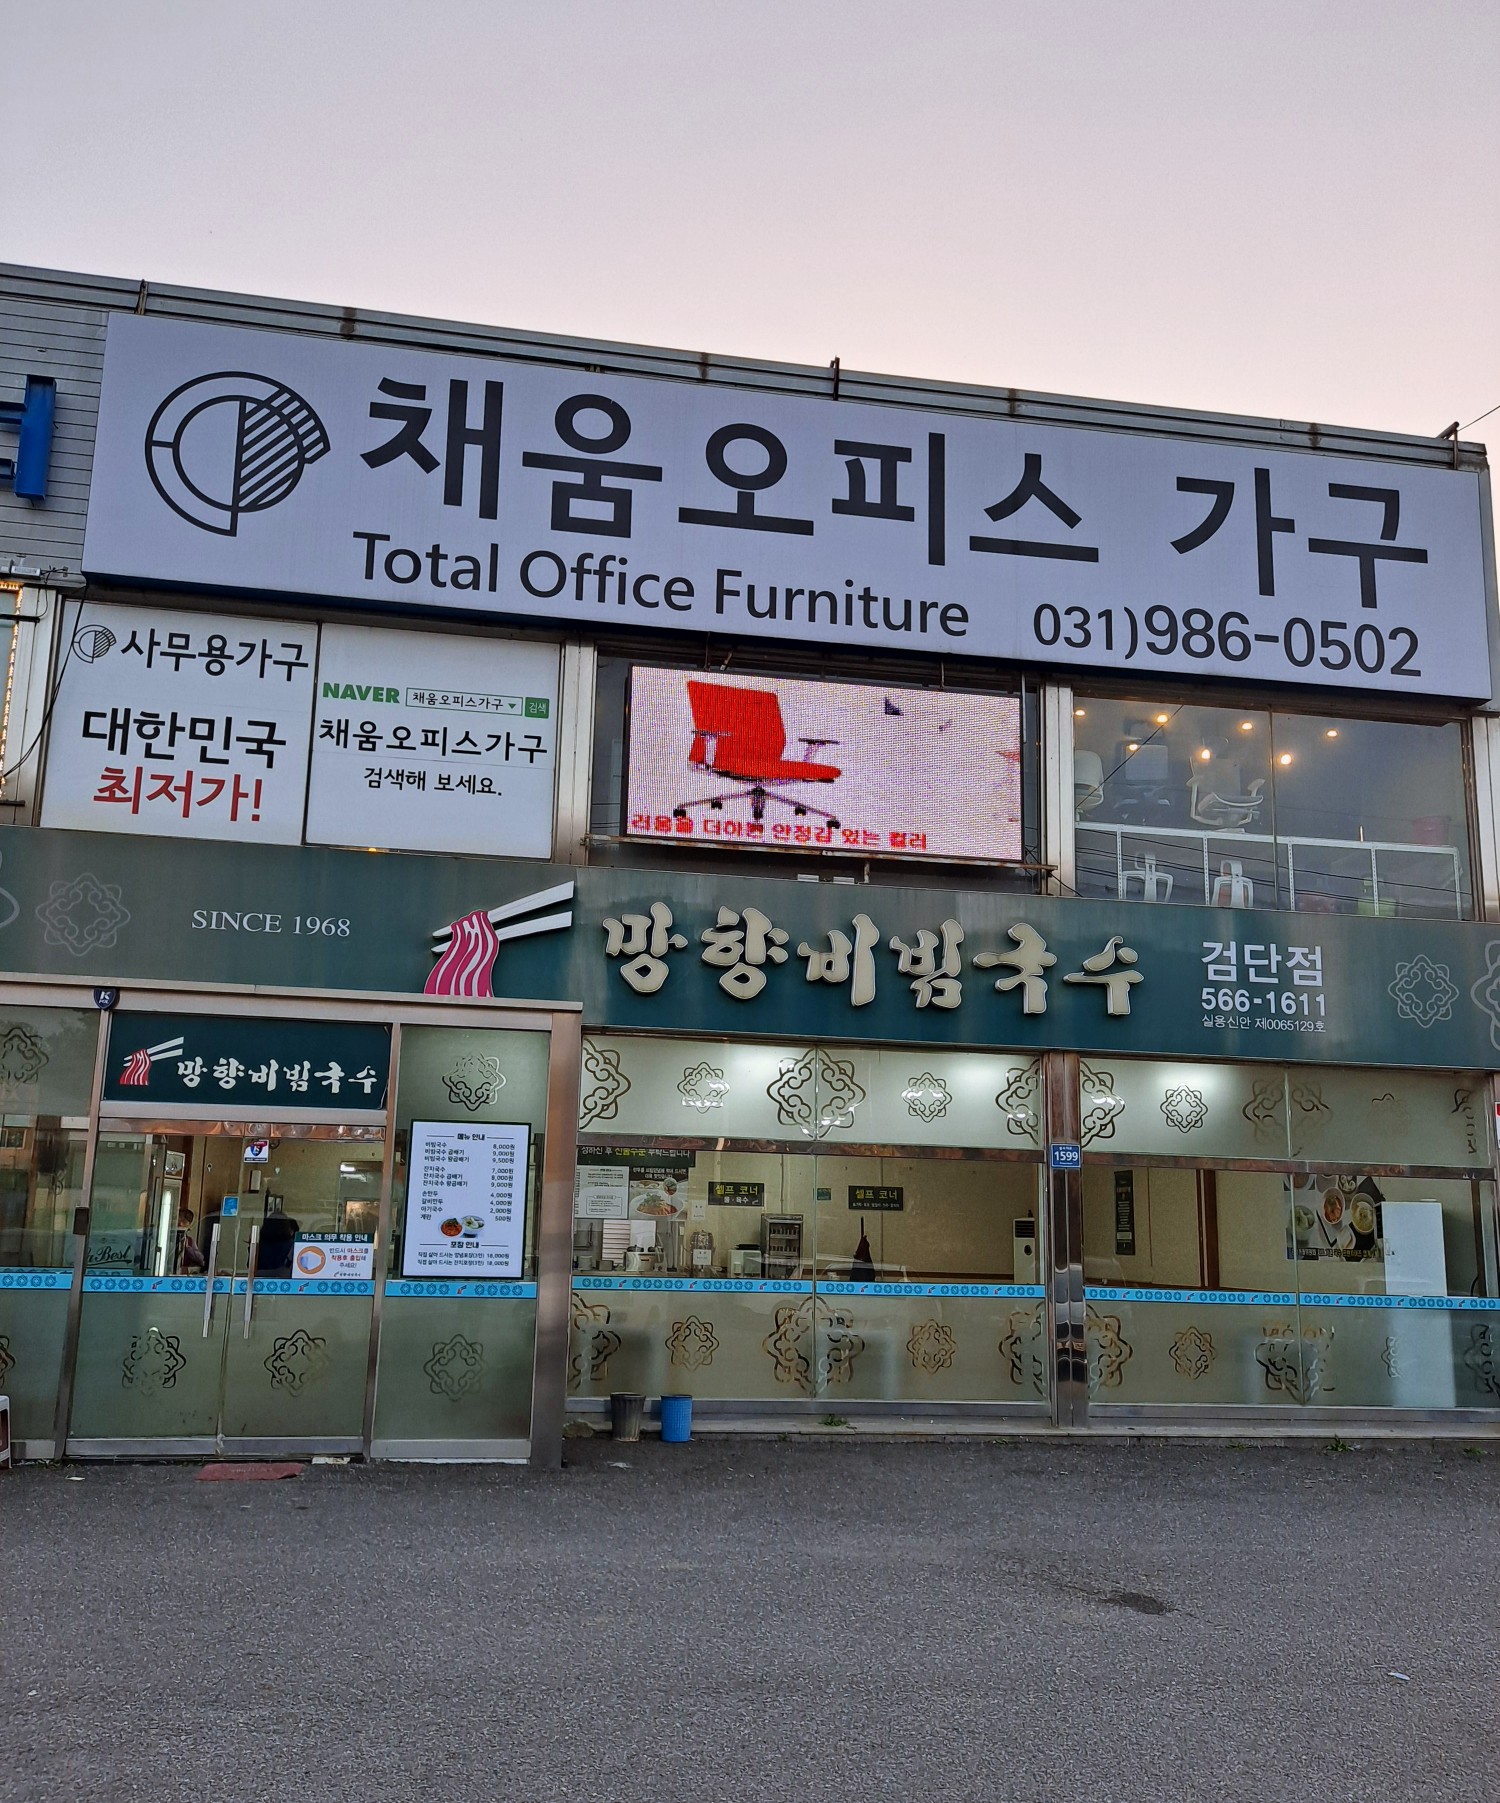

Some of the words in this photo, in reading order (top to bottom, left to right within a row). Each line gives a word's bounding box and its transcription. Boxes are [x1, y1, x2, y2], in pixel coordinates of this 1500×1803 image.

[360, 377, 1099, 566] 채움오피스
[1169, 467, 1428, 609] 가구
[352, 531, 498, 593] Total
[519, 550, 695, 611] Office
[716, 569, 969, 636] Furniture
[120, 627, 309, 682] 사무용가구
[1033, 603, 1421, 677] 031)986-0502
[322, 682, 400, 704] NAVER
[412, 691, 505, 712] 채움오피스가구
[528, 700, 548, 716] 검색
[82, 707, 286, 769] 대한민국
[319, 718, 548, 765] 채움오피스가구
[93, 766, 263, 822] 최저가!
[363, 766, 426, 792] 검색해
[434, 771, 503, 797] 보세요.
[192, 909, 282, 933] SINCE
[292, 915, 351, 938] 1968
[602, 901, 1145, 1016] 망향비빔국수
[1201, 941, 1324, 987] 검단점
[1201, 988, 1326, 1016] 566-1611
[1201, 1014, 1252, 1030] 실용신안
[1254, 1016, 1327, 1033] 제0065129호
[177, 1057, 378, 1093] 망향비빔국수
[1054, 1151, 1078, 1161] 1599
[715, 1184, 735, 1195] 셀프
[739, 1185, 758, 1195] 코너
[855, 1188, 874, 1199] 셀프
[879, 1190, 897, 1200] 코너
[324, 1233, 338, 1241] 의무
[354, 1234, 368, 1242] 안내
